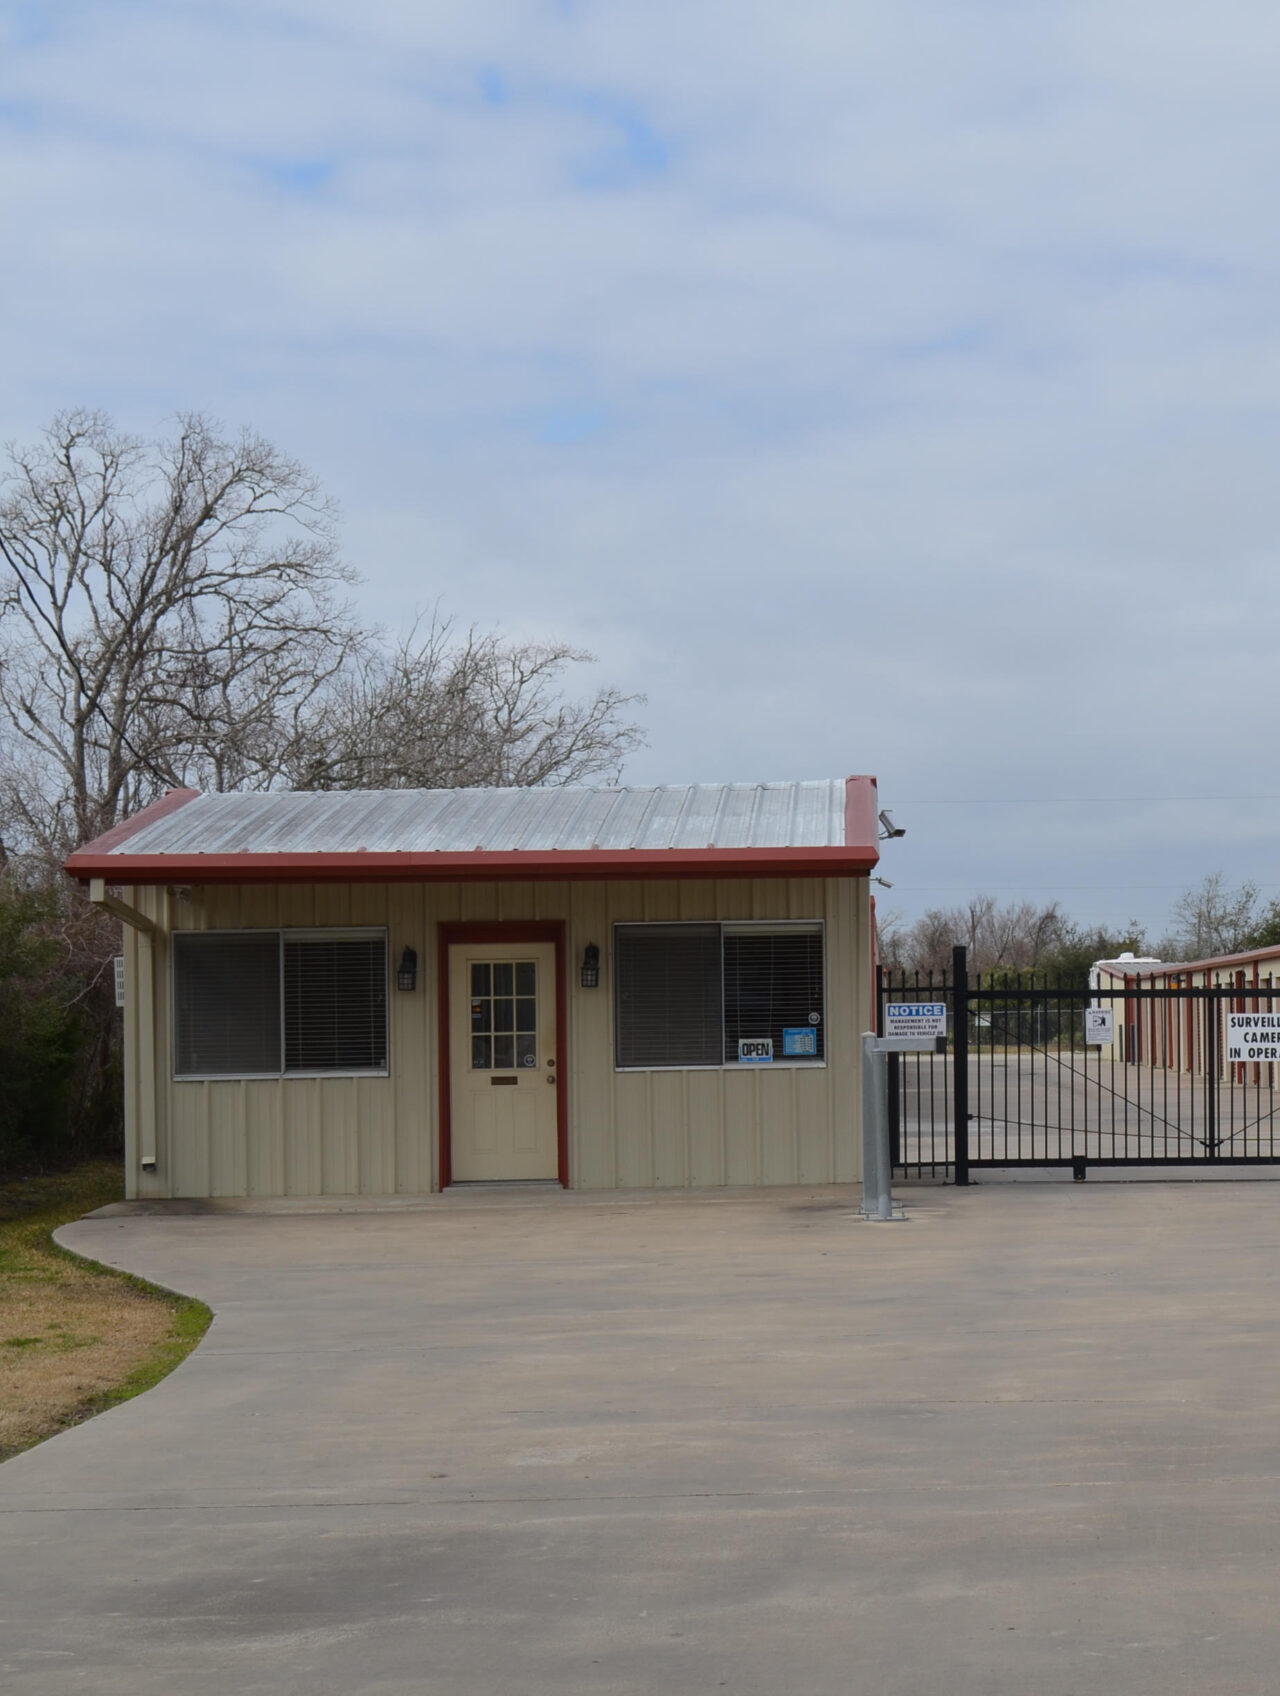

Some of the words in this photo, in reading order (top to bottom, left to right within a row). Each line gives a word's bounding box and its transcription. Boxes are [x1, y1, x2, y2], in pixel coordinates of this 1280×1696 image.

[889, 1006, 942, 1016] NOTICE
[742, 1043, 769, 1056] OPEN
[1229, 1047, 1241, 1059] IN
